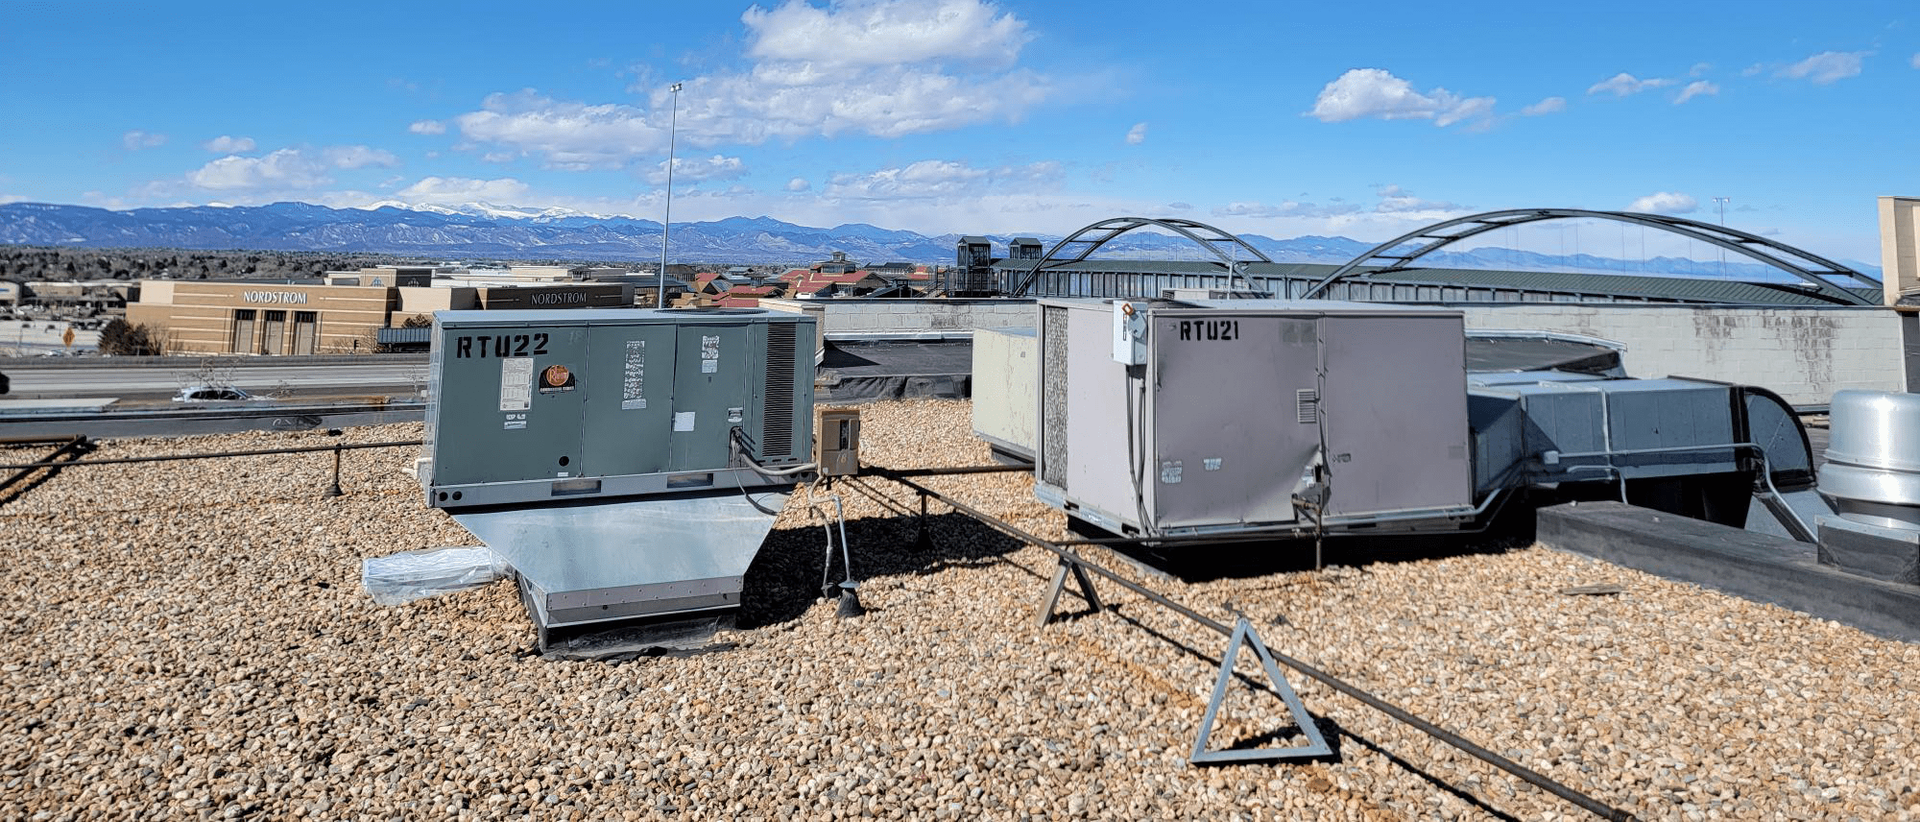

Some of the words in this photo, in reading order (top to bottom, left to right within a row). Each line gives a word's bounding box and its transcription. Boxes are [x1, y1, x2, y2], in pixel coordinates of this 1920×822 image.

[243, 290, 308, 304] NORDSTROM
[531, 292, 587, 305] NORDSTROM
[1180, 320, 1239, 341] RTU21
[456, 333, 549, 358] RTU22
